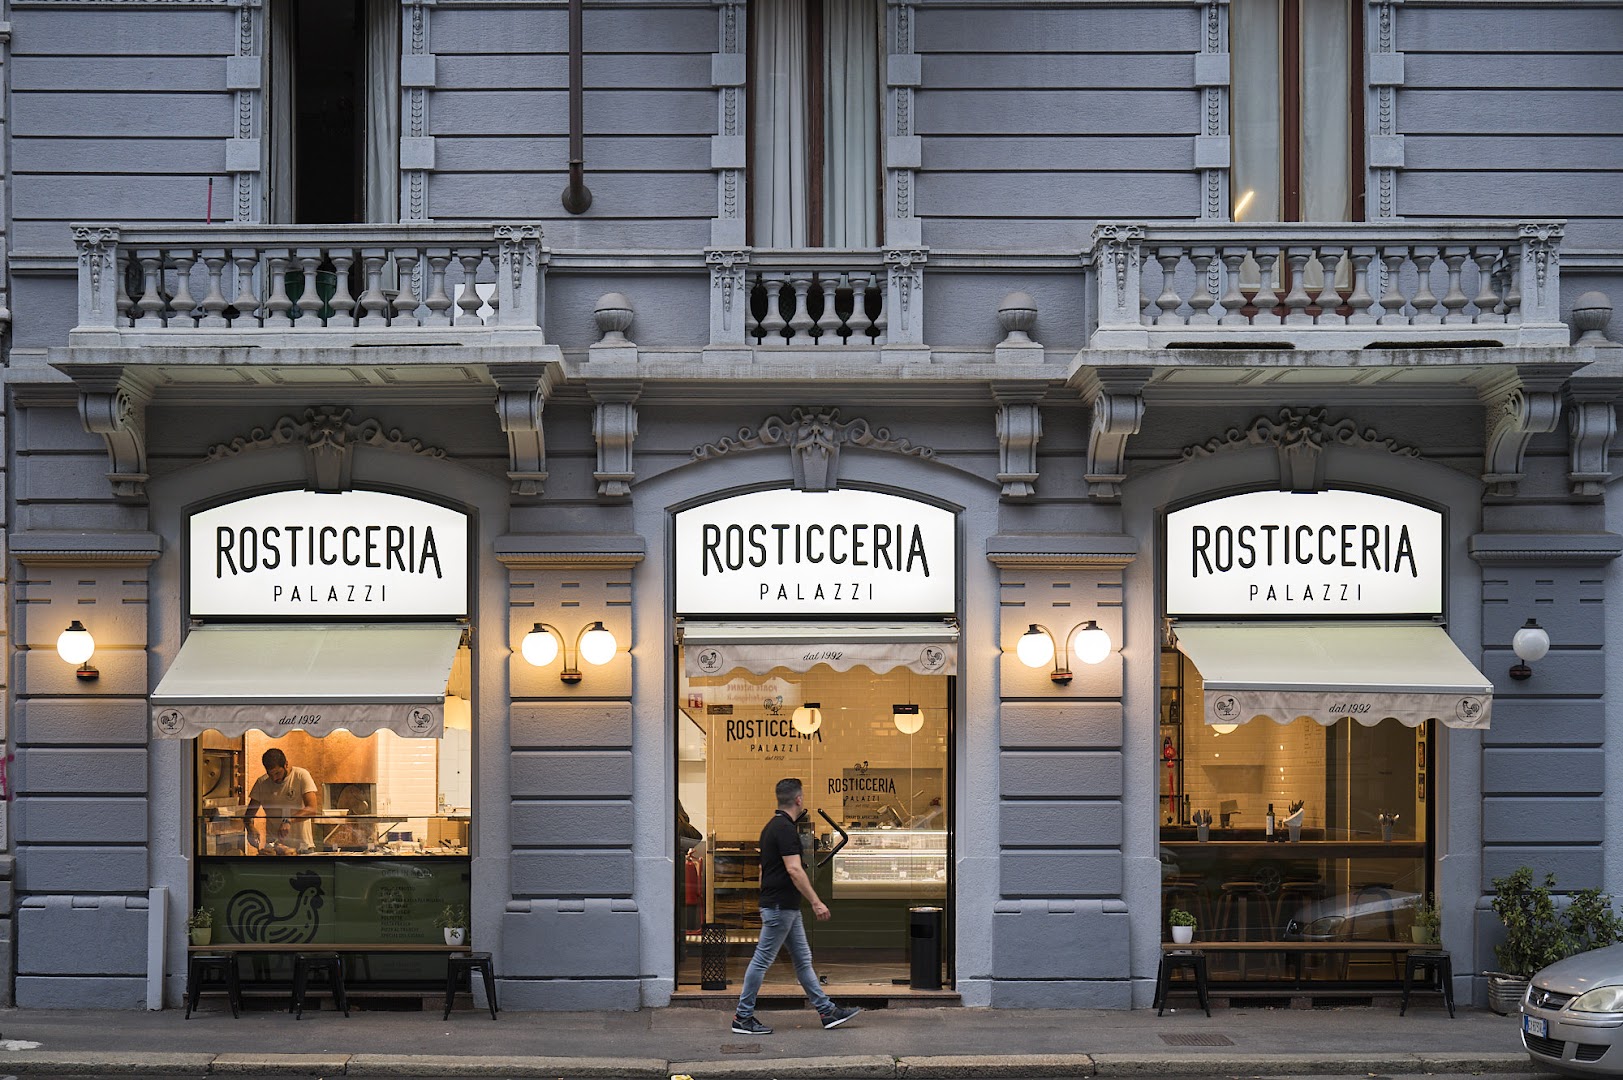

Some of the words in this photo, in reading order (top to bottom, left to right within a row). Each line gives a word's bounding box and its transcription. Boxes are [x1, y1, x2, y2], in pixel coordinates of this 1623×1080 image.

[216, 525, 443, 579] ROSTICCERIA
[702, 523, 930, 578] ROSTICCERIA
[1192, 524, 1418, 579] ROSTICCERIA
[273, 584, 386, 603] PALAZZI
[759, 582, 873, 601] PALAZZI
[1249, 583, 1361, 602] PALAZZI
[803, 652, 819, 661] dal
[821, 651, 843, 660] 1992
[1329, 703, 1346, 713] dal
[1348, 703, 1371, 713] 1992
[278, 715, 297, 725] dal
[298, 714, 322, 725] 1992
[726, 719, 822, 743] ROSTICCEA
[750, 744, 799, 752] PALAZZI
[828, 777, 897, 795] ROSTICCERIA
